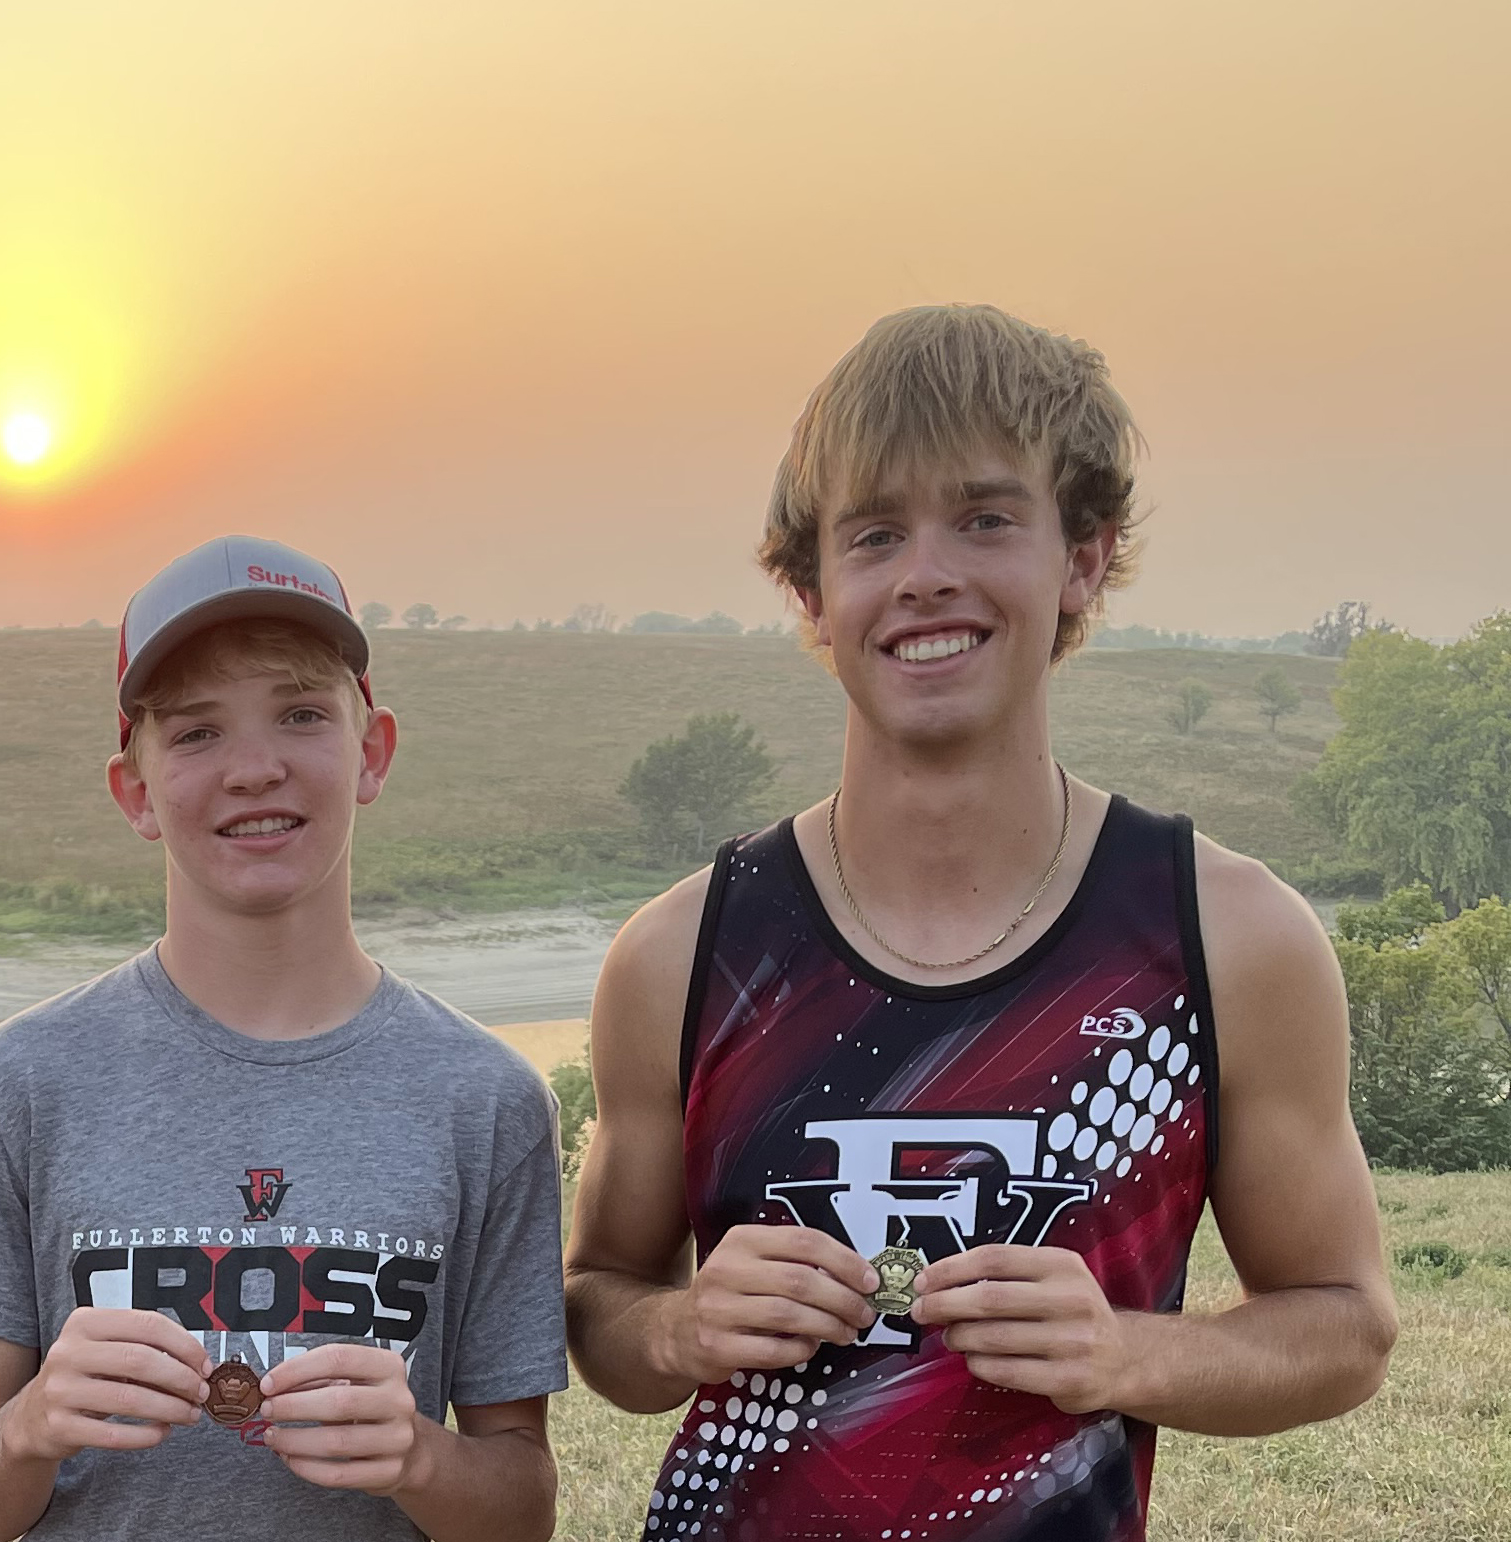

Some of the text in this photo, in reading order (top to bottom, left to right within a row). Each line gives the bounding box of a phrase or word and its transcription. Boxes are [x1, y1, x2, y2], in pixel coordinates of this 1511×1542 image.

[1079, 1014, 1127, 1034] PCS
[72, 1226, 445, 1261] FULLERTON WARRIORS
[72, 1246, 440, 1341] CROSS
